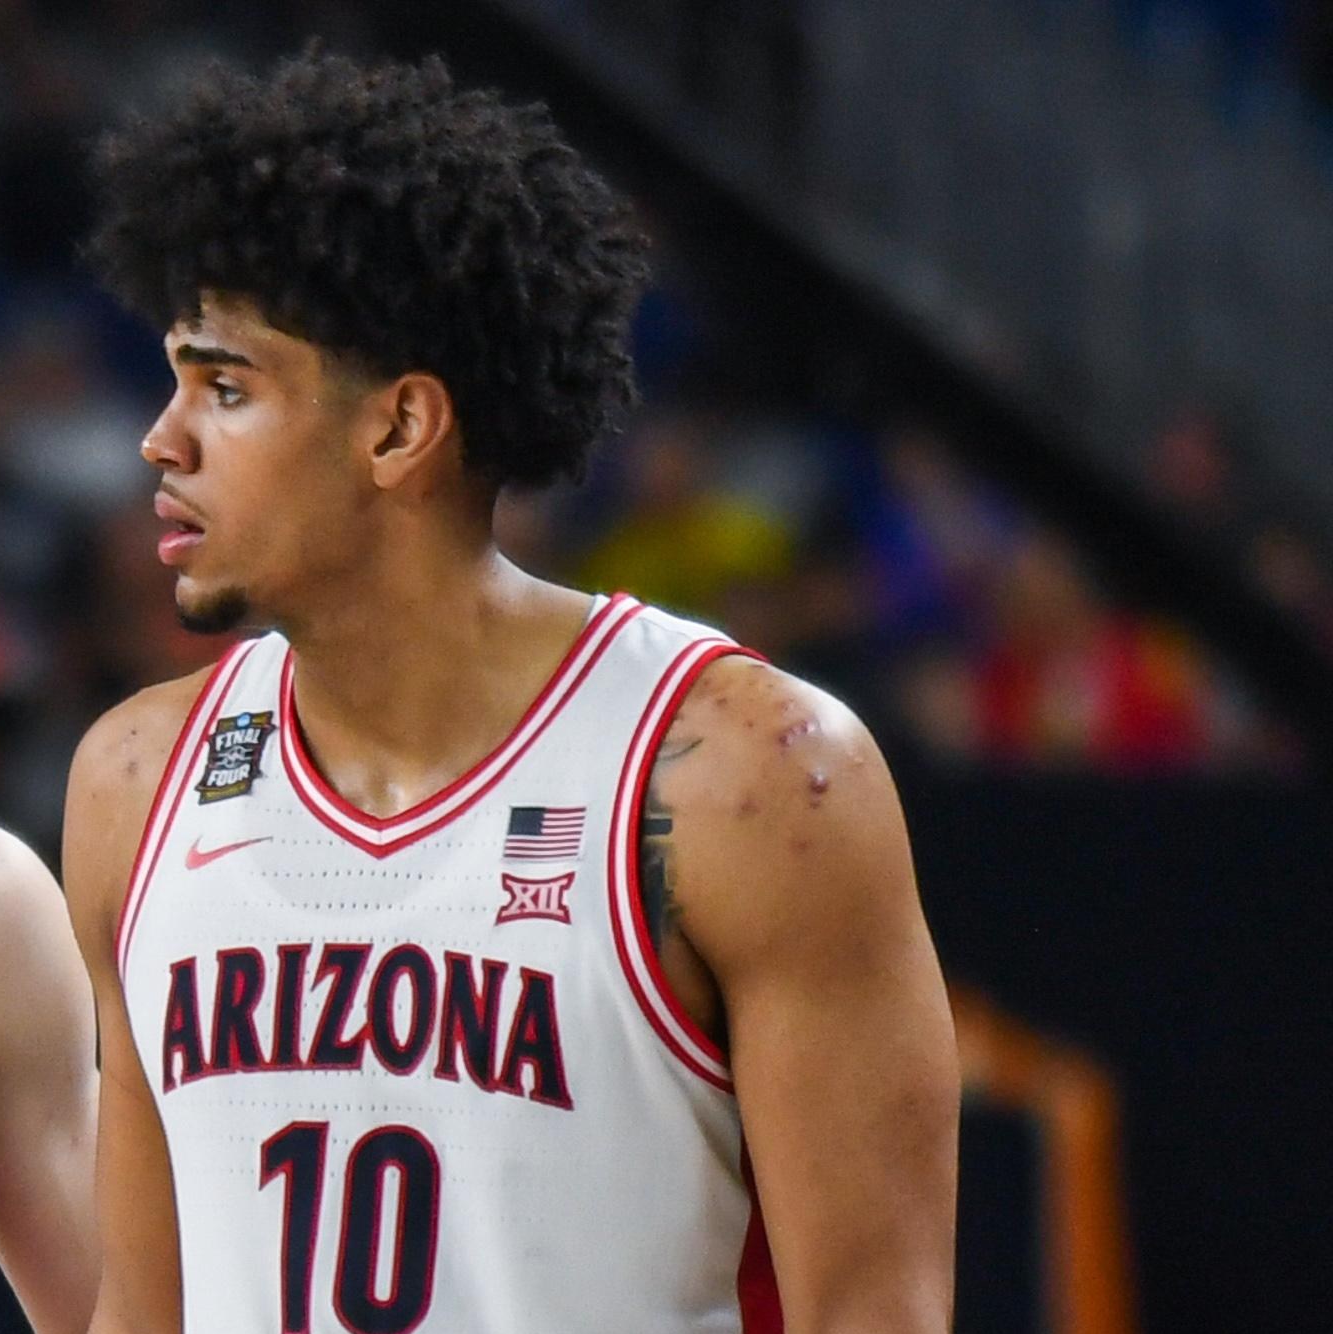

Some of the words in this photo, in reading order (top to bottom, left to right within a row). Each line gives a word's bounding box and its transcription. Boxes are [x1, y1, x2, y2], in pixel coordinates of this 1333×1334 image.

[214, 728, 262, 751] FINAL
[206, 764, 251, 787] FOUR
[162, 942, 574, 1111] ARIZONA
